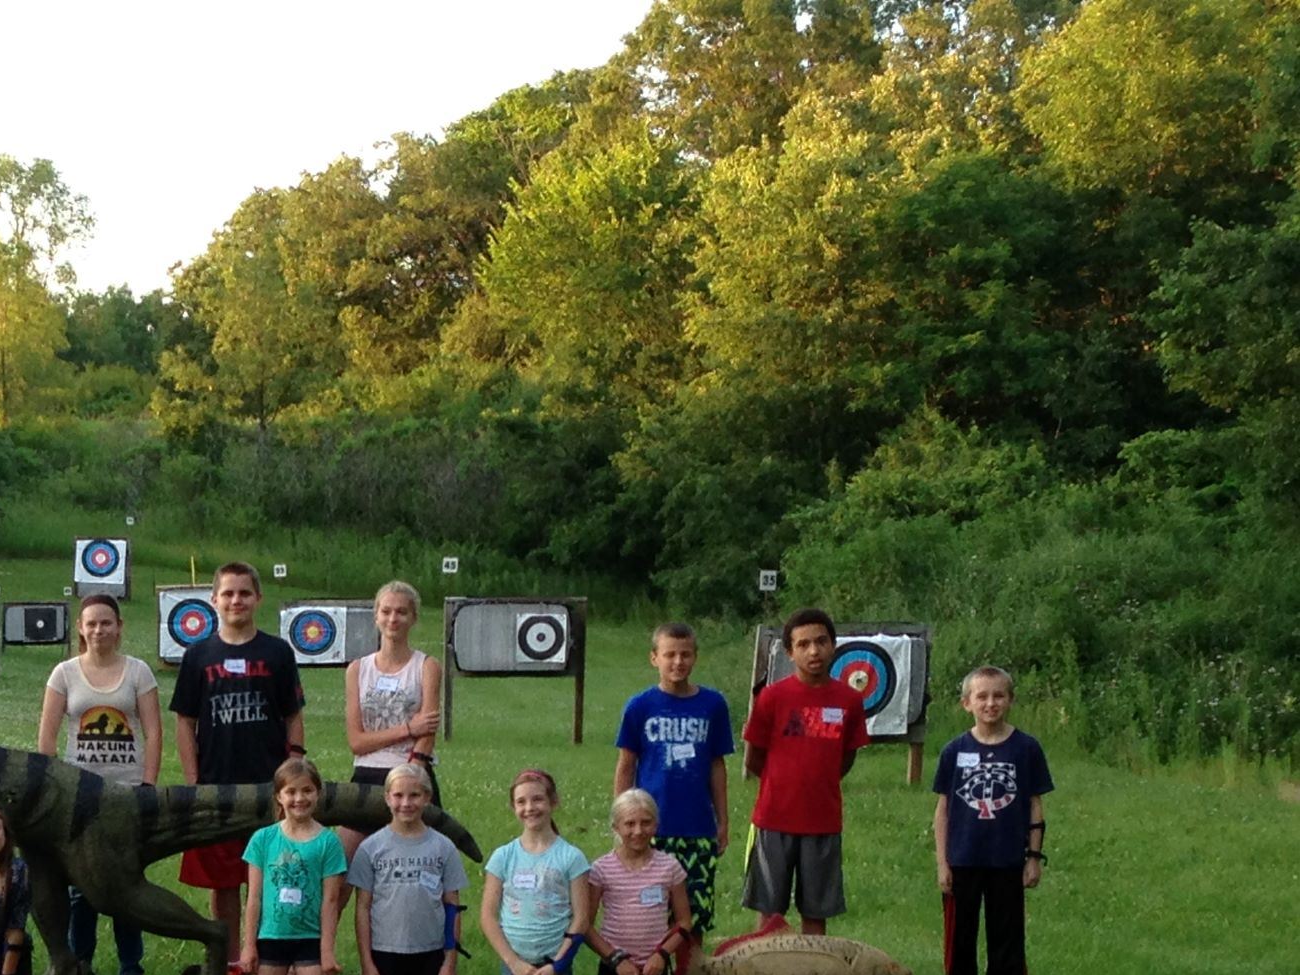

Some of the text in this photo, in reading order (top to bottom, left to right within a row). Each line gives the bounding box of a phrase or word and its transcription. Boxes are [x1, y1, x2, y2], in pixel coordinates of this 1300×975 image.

[763, 575, 776, 586] 35
[644, 716, 709, 743] CRUSH
[77, 741, 136, 751] HAKUNA
[77, 753, 137, 763] MATATA
